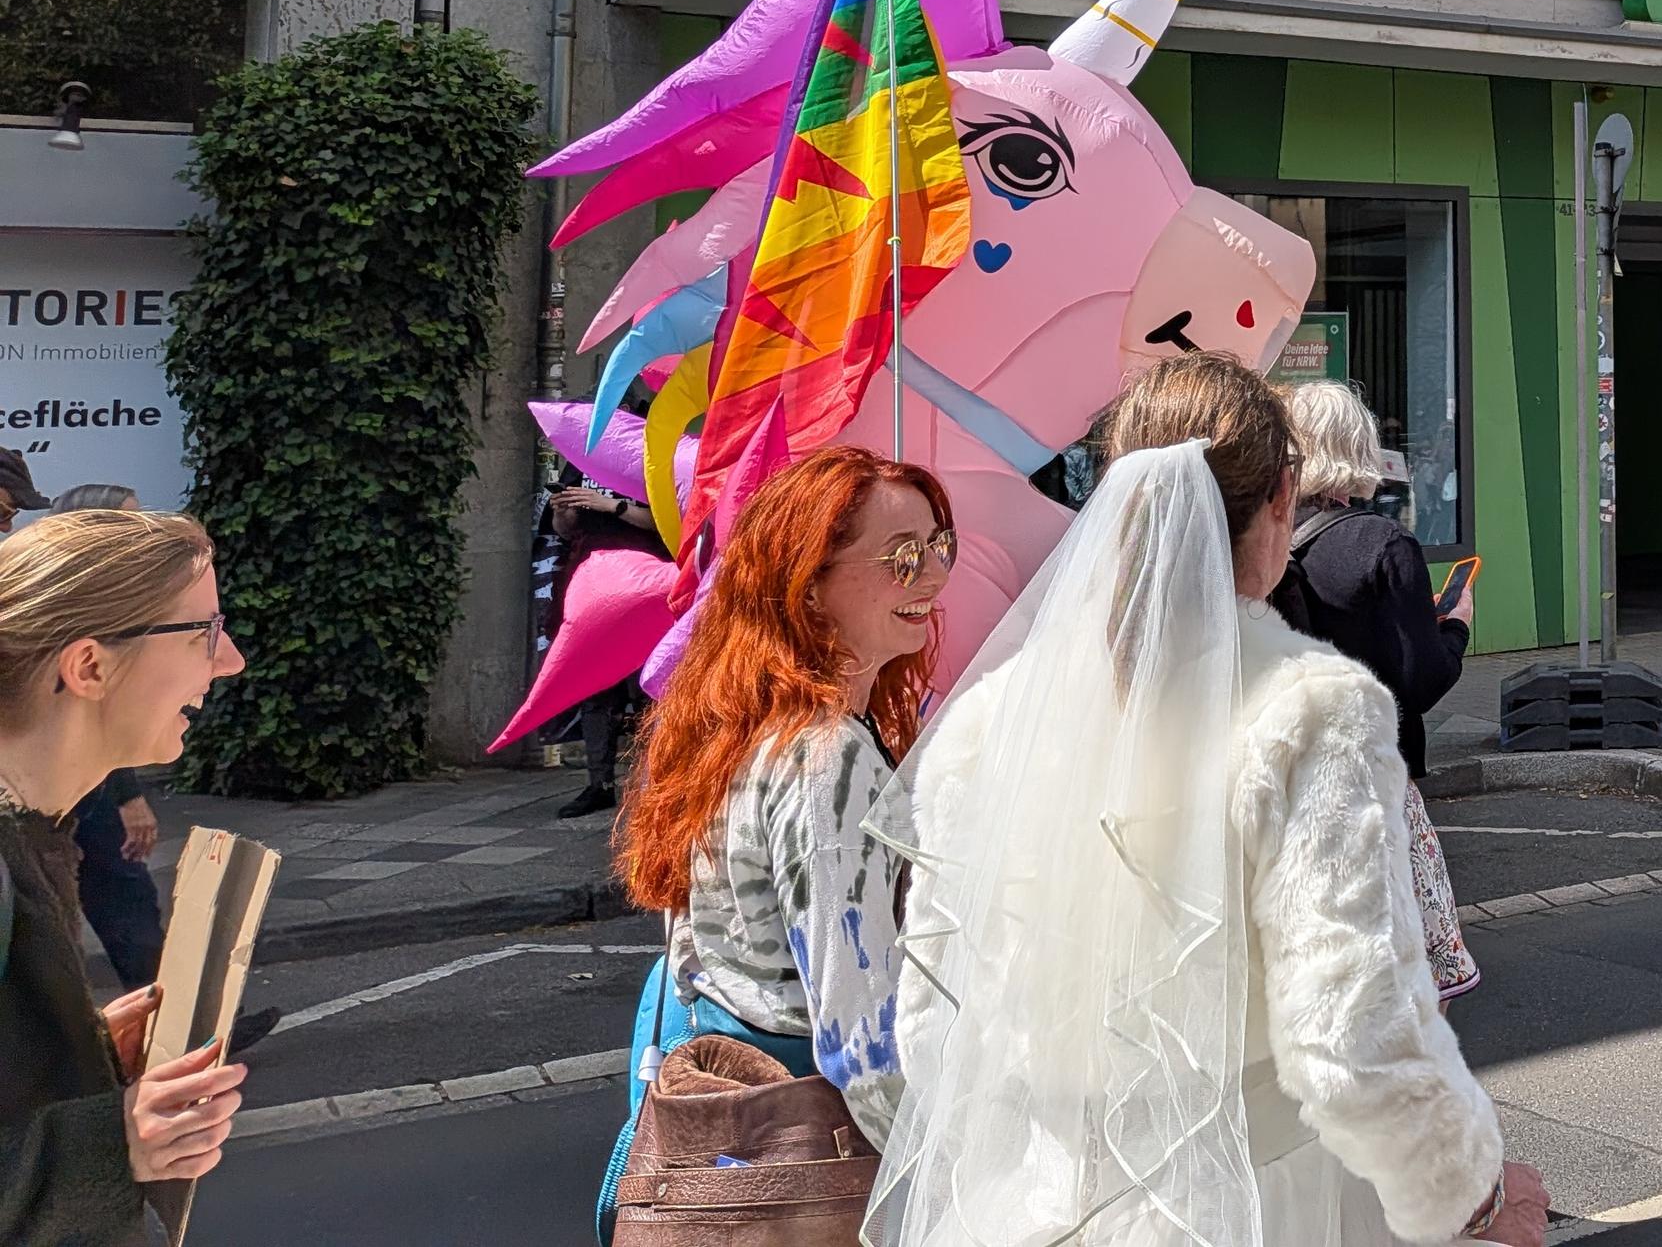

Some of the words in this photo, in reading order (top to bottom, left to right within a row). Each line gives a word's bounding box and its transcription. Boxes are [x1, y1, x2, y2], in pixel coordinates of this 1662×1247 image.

[0, 290, 184, 326] TORIE
[34, 343, 157, 360] Immobilien
[1284, 343, 1309, 355] Deine
[1310, 343, 1329, 355] Idee
[1282, 355, 1296, 367] für
[1296, 355, 1319, 367] NRW.
